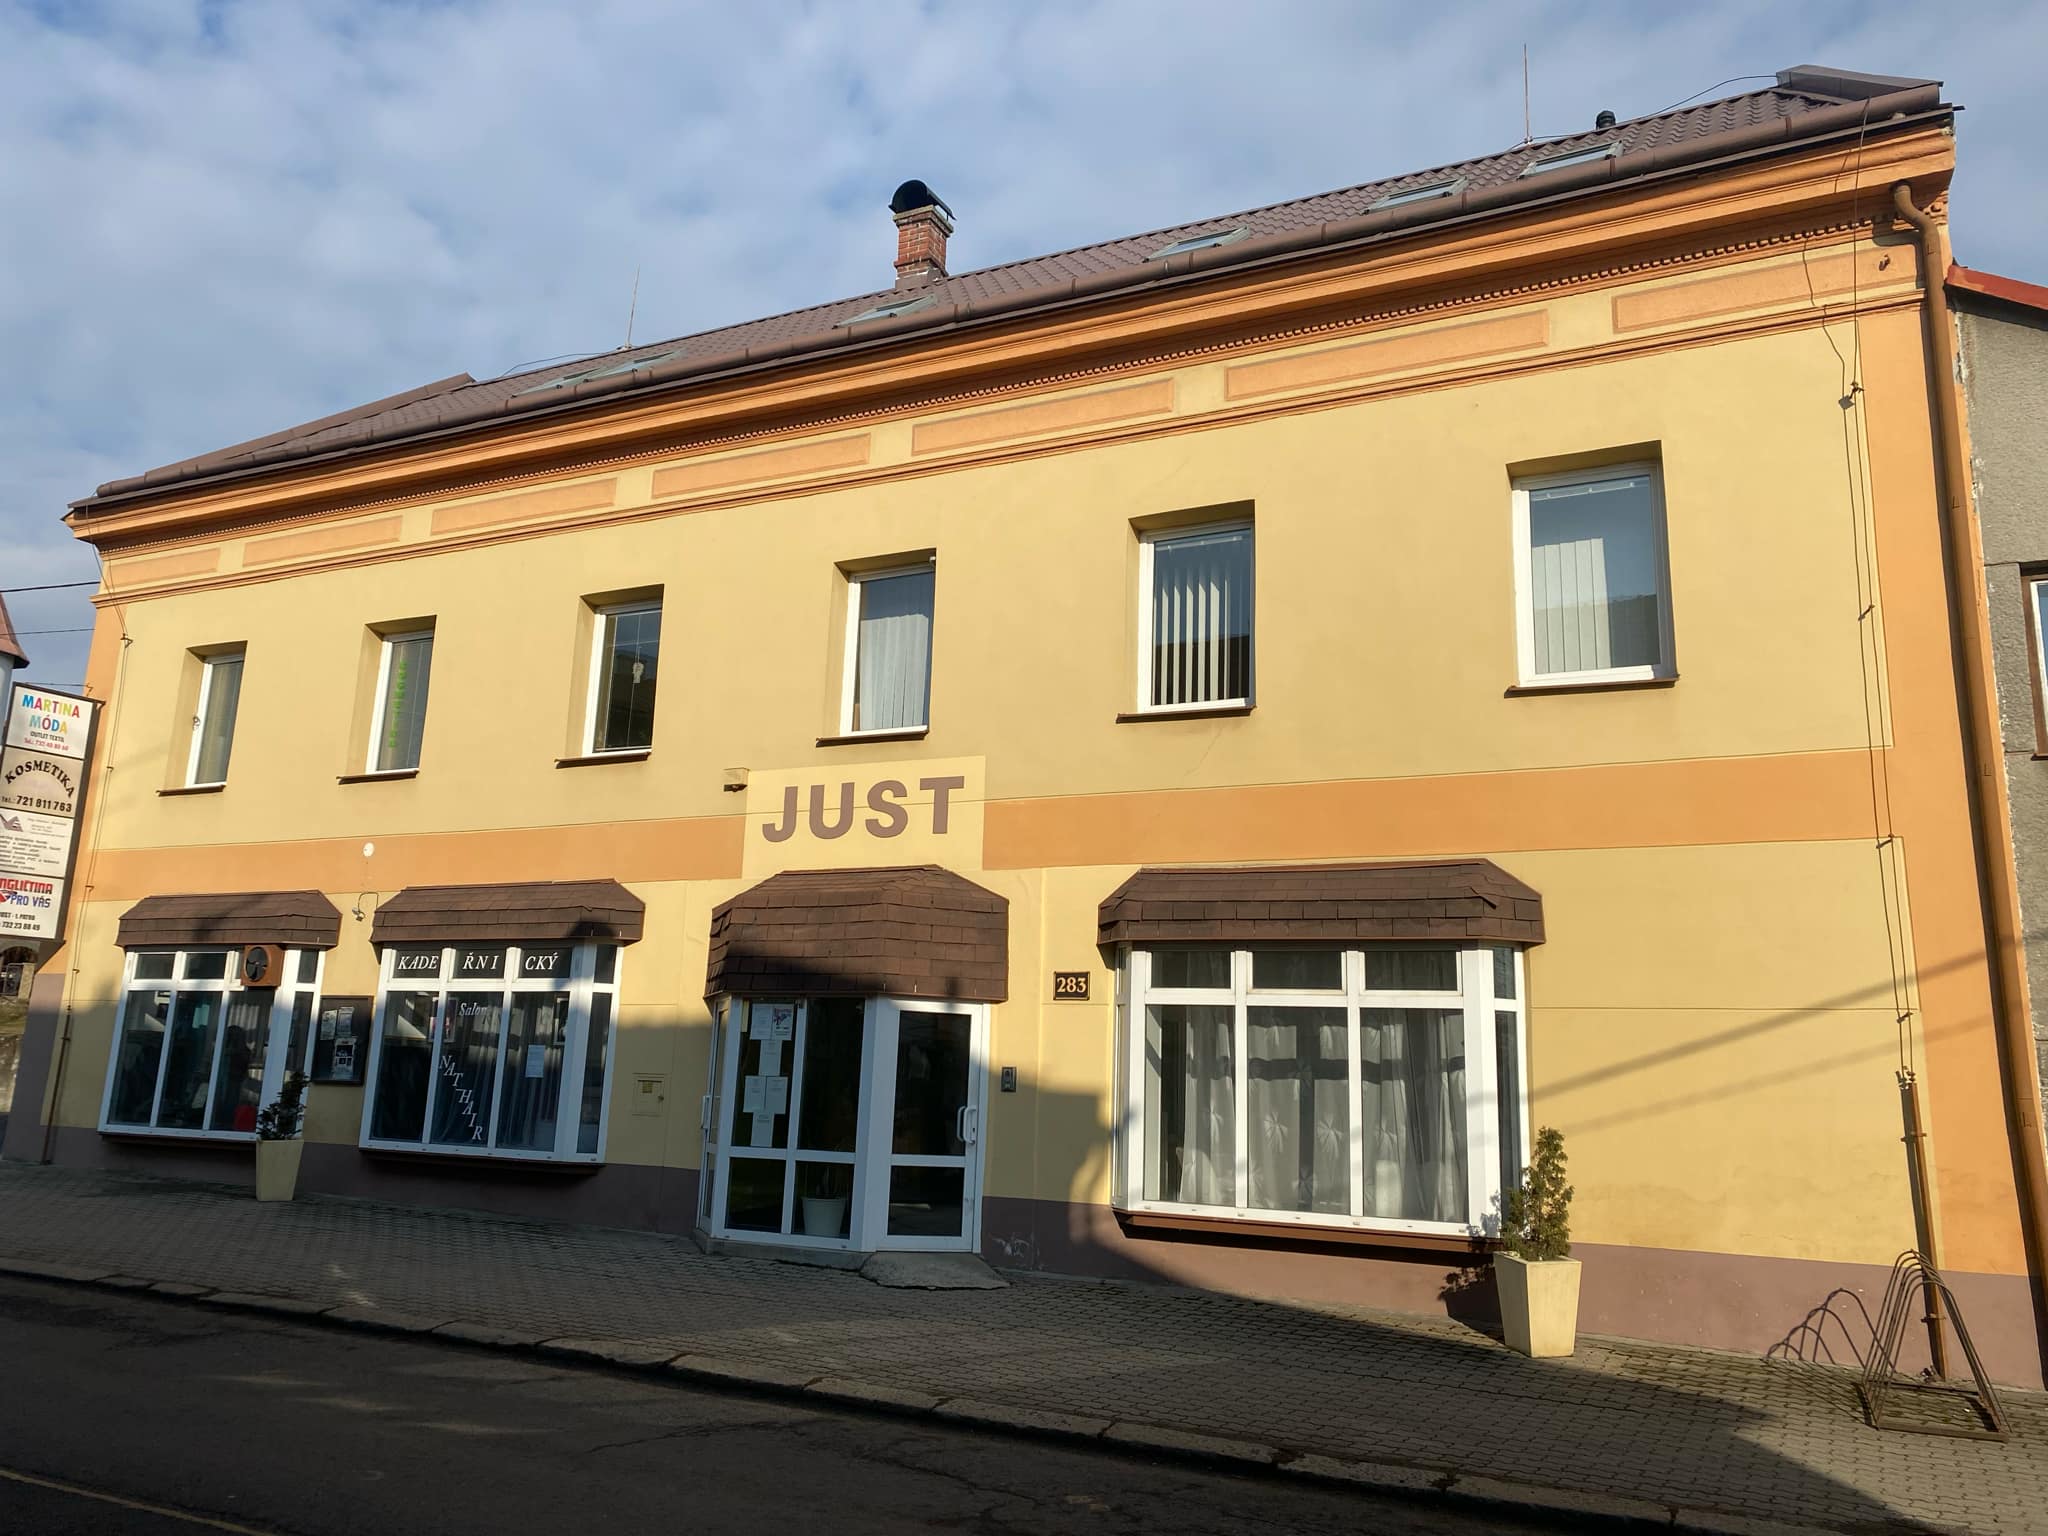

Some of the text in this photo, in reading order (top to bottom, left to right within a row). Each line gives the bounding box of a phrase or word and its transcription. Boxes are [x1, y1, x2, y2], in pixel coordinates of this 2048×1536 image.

[22, 694, 80, 718] MARTINA
[29, 714, 67, 734] MÓDA
[5, 760, 75, 798] KOSMETIKA
[16, 796, 33, 807] 721
[36, 799, 52, 810] 811
[54, 801, 72, 812] 763
[762, 775, 965, 843] JUST
[10, 893, 51, 908] PRO VÁS
[397, 955, 439, 970] KADE
[525, 952, 558, 970] CKÝ
[1057, 977, 1086, 992] 283
[459, 1002, 488, 1017] Salon
